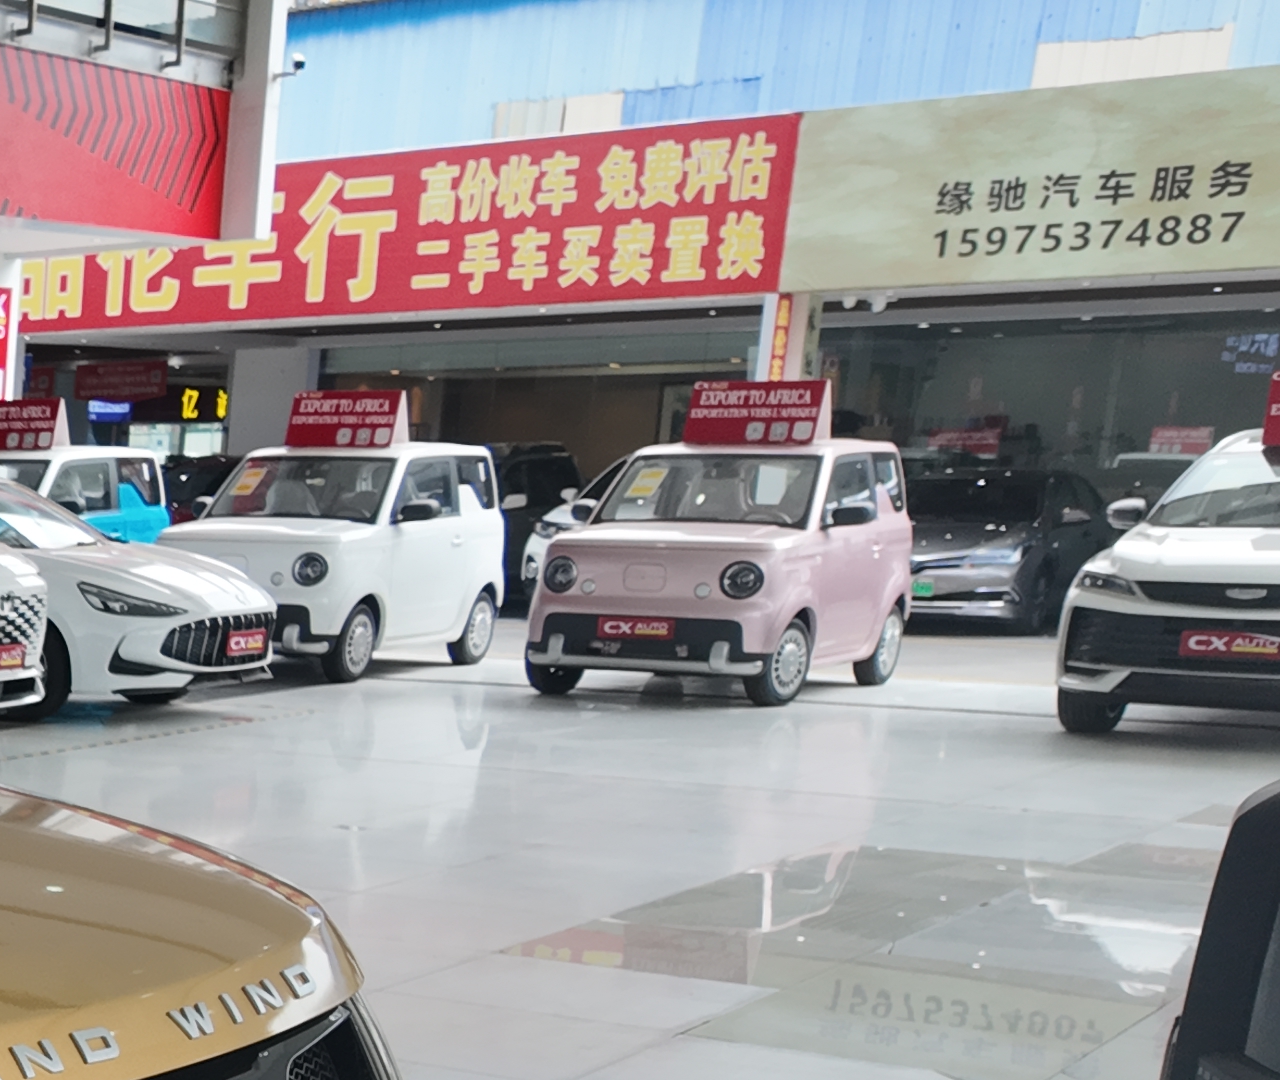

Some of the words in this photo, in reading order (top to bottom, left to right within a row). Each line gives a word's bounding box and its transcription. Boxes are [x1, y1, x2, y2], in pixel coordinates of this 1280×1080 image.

[417, 150, 581, 226] 高价收车
[594, 131, 778, 213] 免费评估
[934, 160, 1254, 216] 缘驰汽车服务
[410, 209, 766, 295] 二手车买卖置换
[933, 211, 1246, 259] 15975374887
[699, 390, 748, 406] EXPORT
[749, 389, 766, 405] TO
[766, 388, 811, 404] AFRICA
[230, 634, 247, 650] CX
[603, 620, 634, 635] CX
[634, 622, 669, 632] AUTO
[1187, 634, 1230, 652] CX
[1232, 636, 1279, 649] AUTO
[168, 963, 317, 1040] WIND
